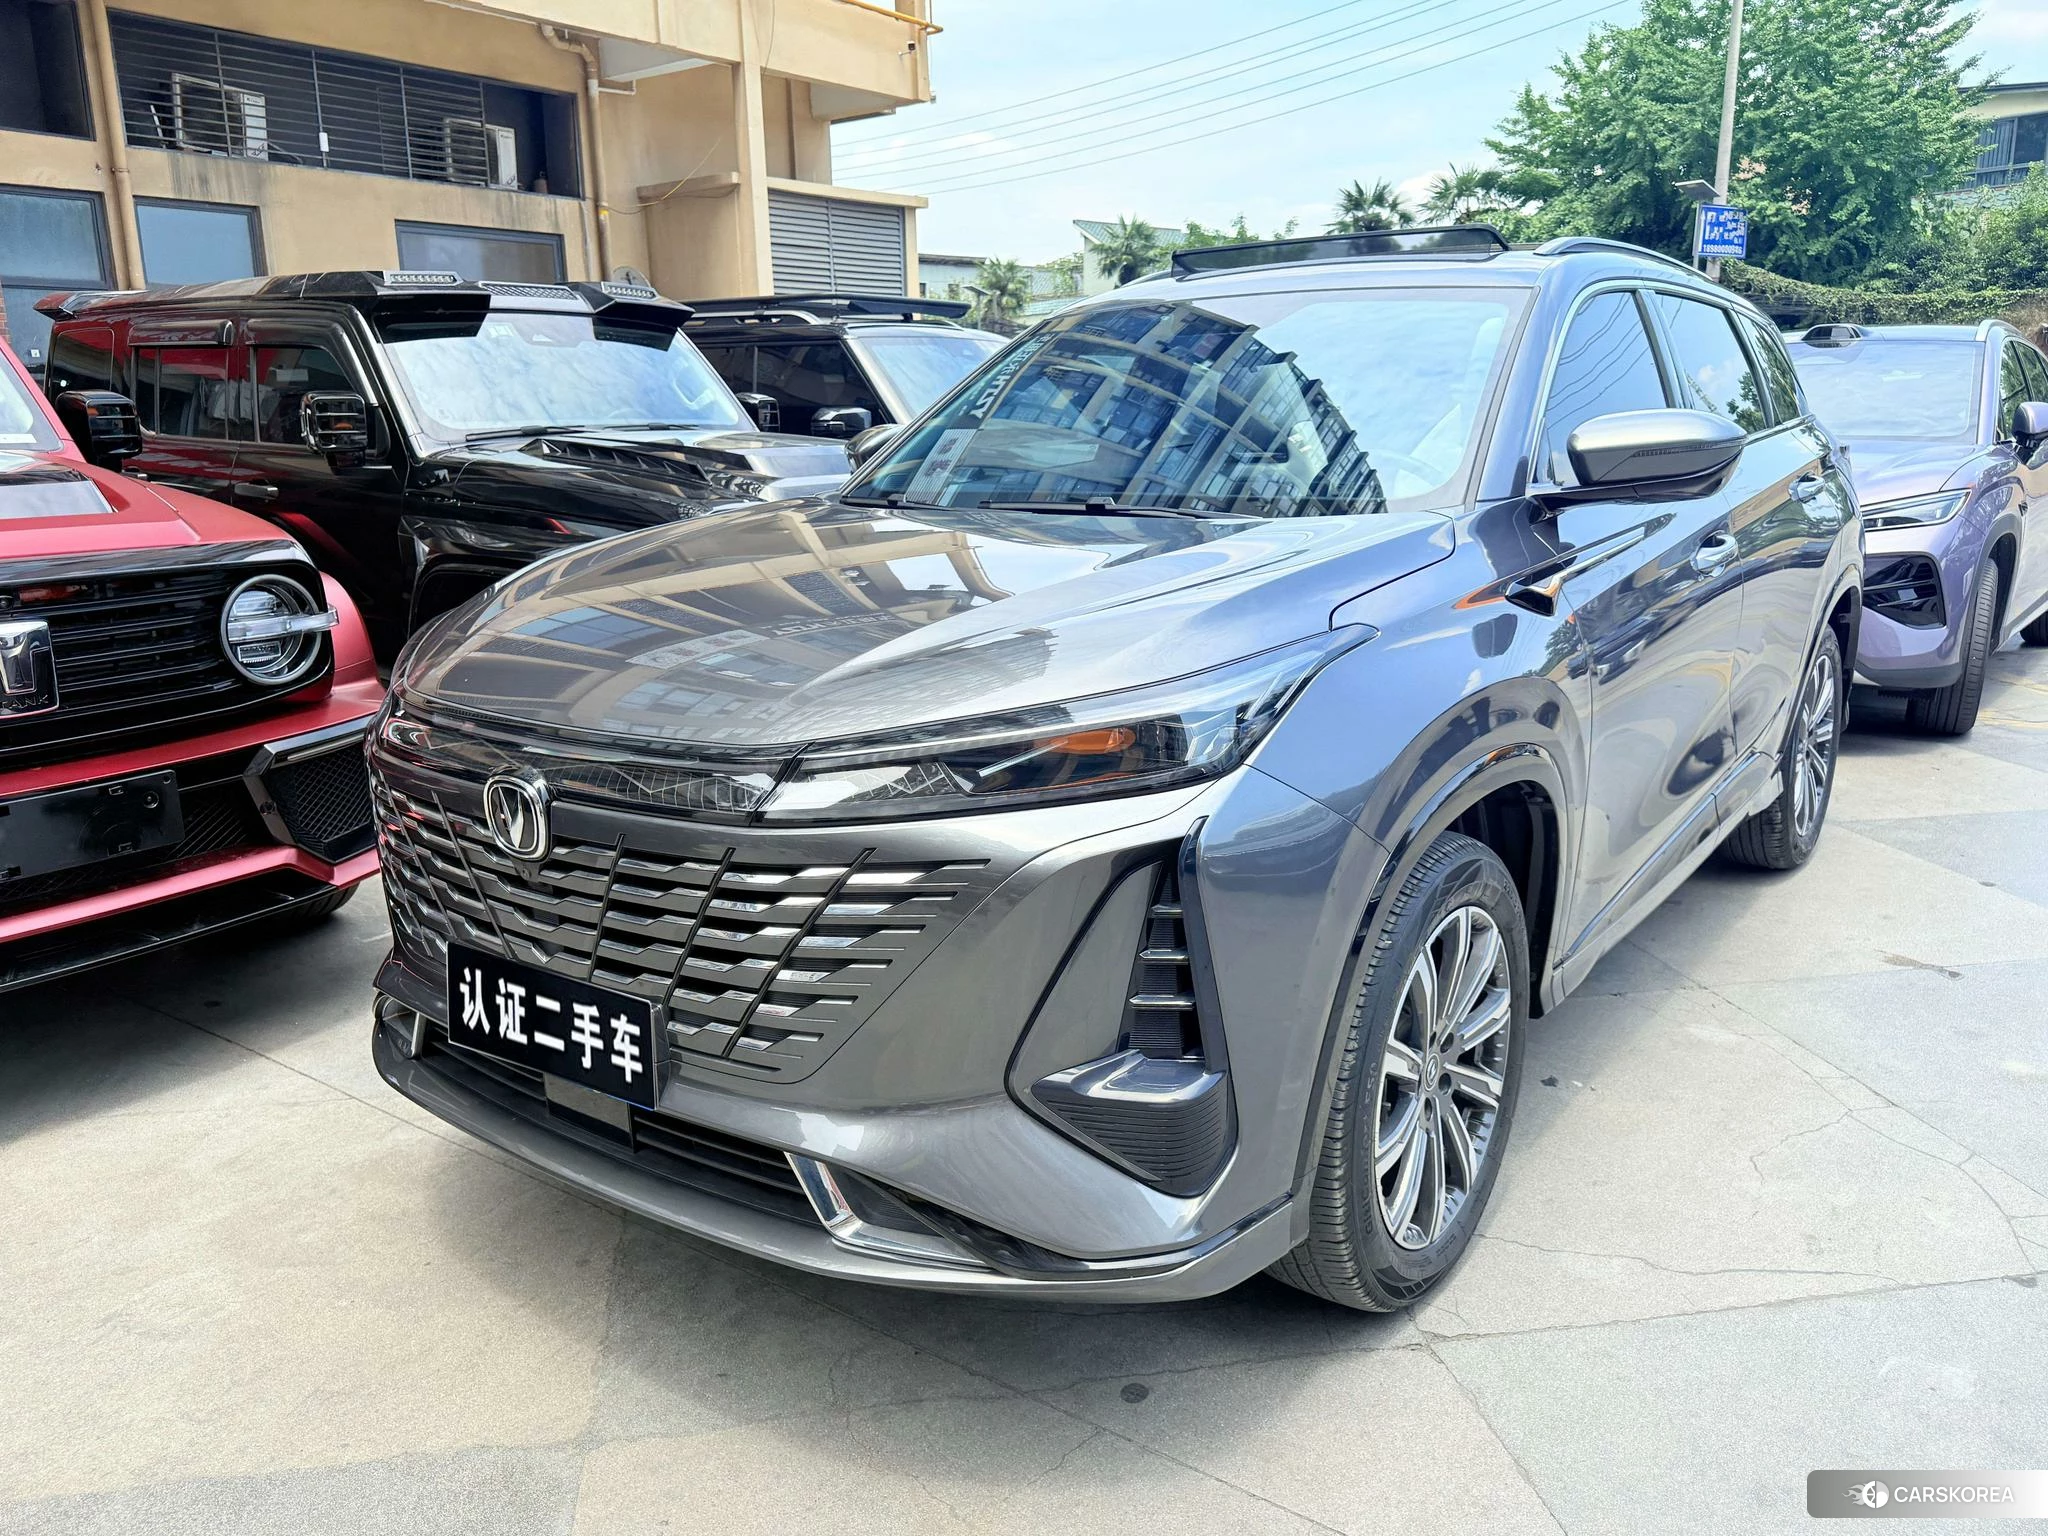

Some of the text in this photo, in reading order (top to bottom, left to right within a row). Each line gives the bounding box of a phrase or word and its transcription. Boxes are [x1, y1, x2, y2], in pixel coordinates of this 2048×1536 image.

[459, 966, 643, 1084] 认证二手车
